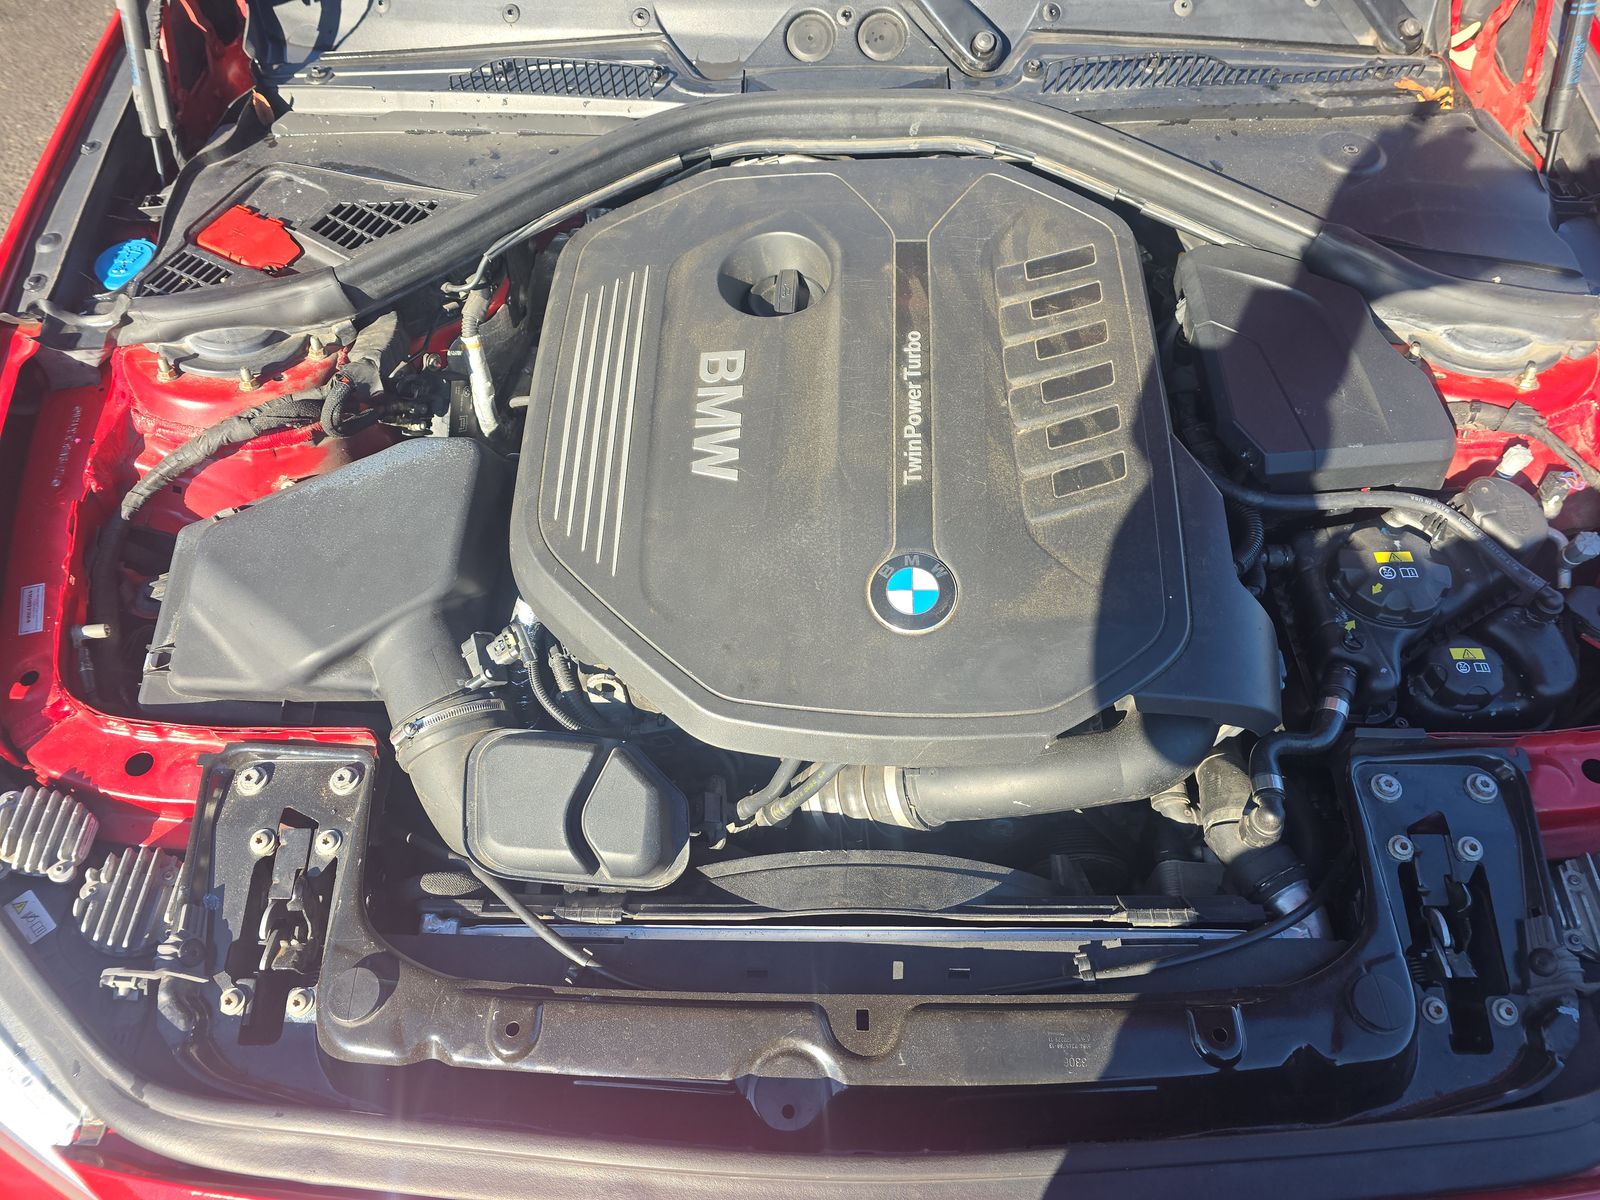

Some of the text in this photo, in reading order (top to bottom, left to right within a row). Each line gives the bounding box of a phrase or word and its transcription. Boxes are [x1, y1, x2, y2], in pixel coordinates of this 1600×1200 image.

[691, 349, 746, 482] BMW
[903, 330, 922, 486] TwinPower Turbo
[878, 554, 948, 579] BMW
